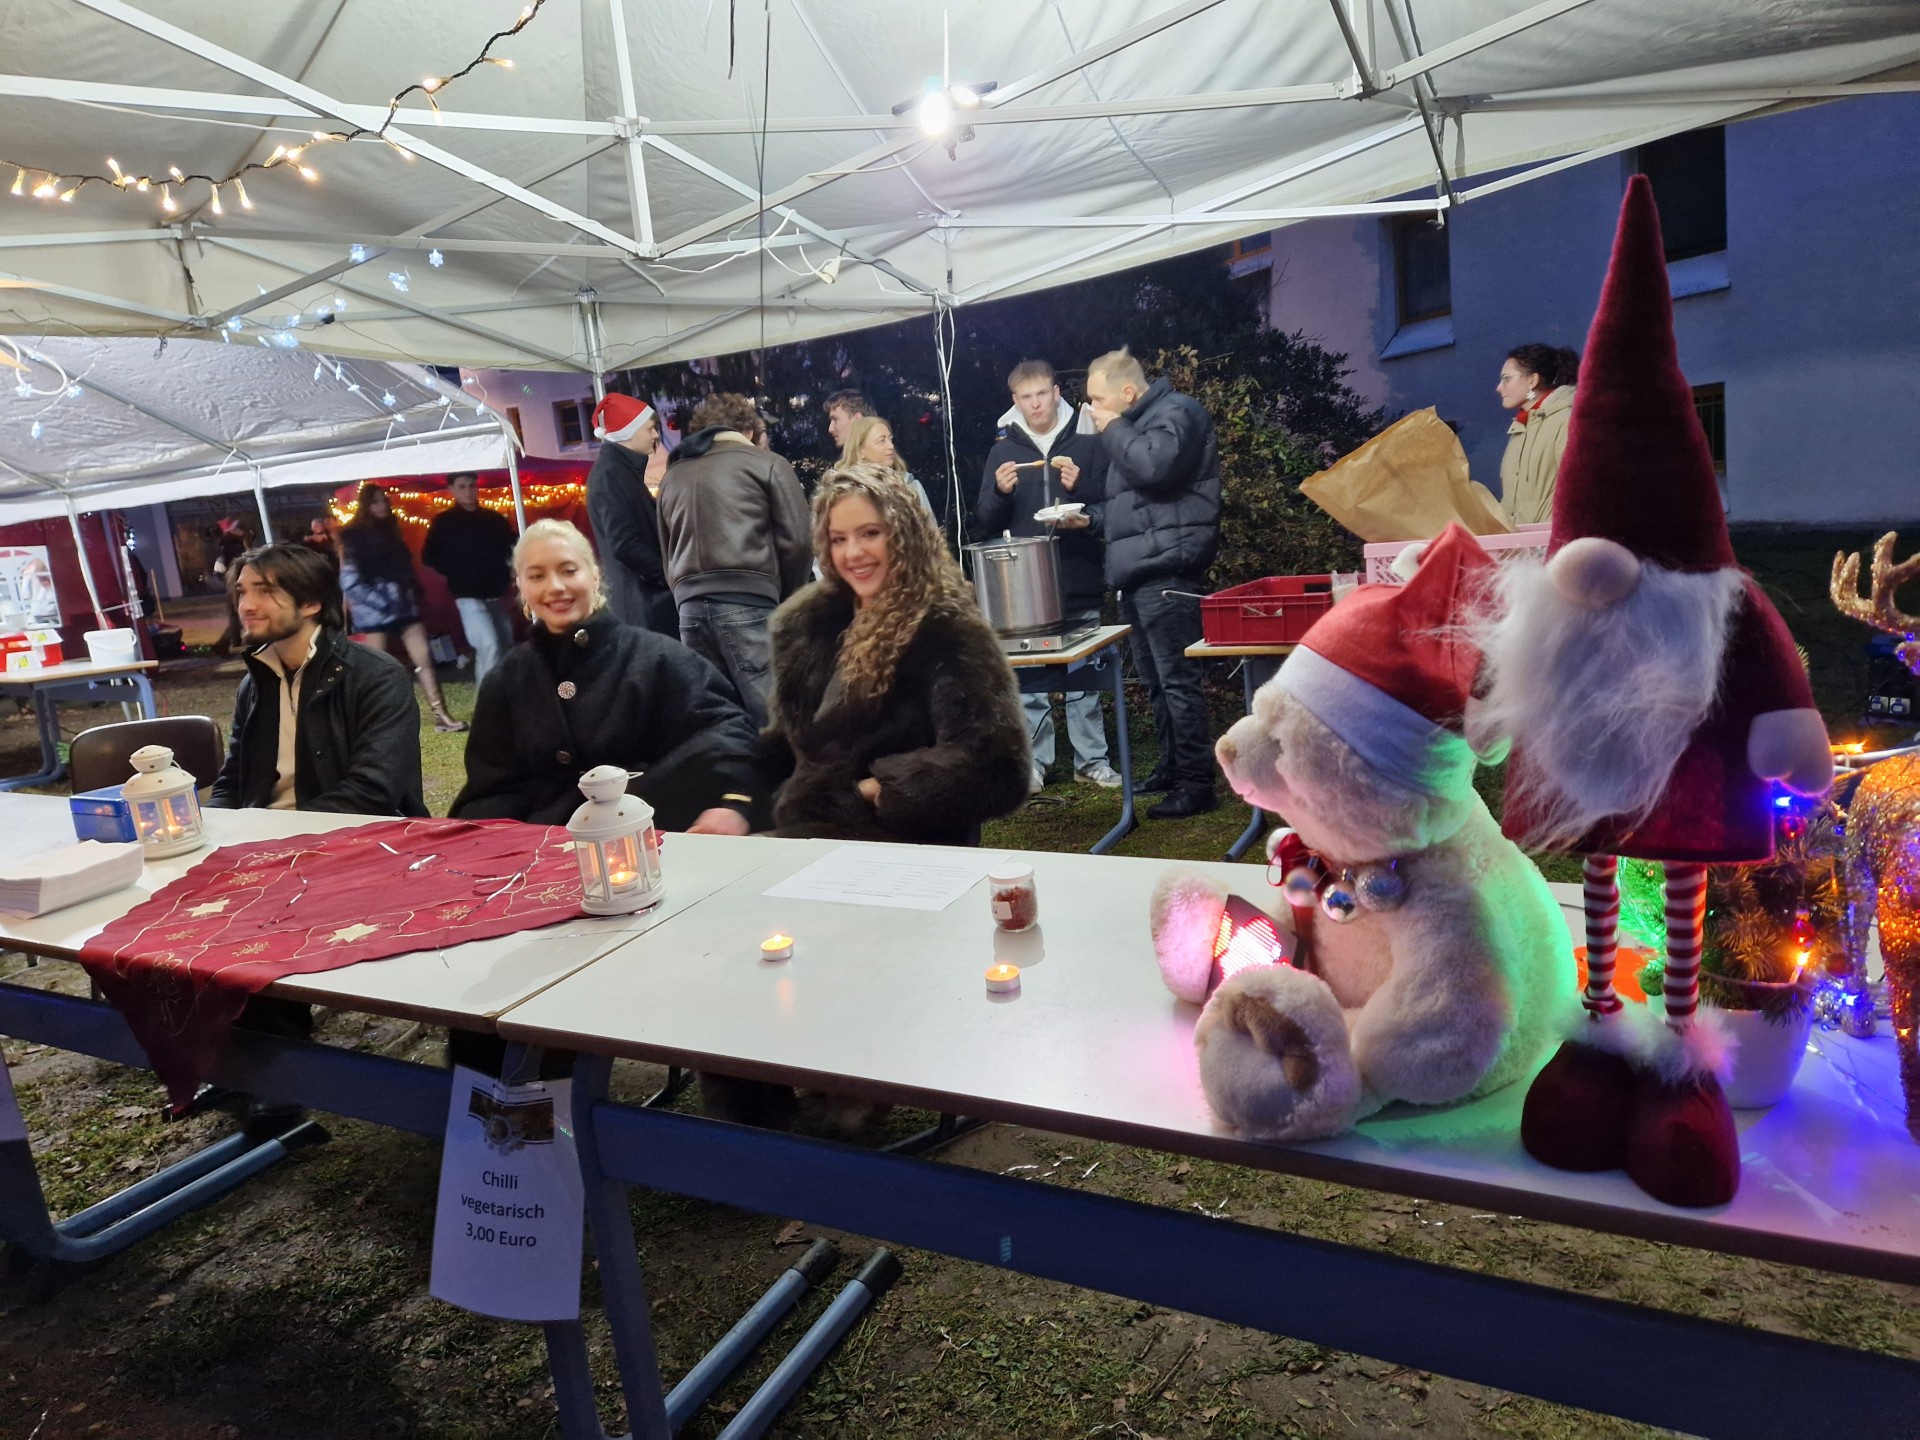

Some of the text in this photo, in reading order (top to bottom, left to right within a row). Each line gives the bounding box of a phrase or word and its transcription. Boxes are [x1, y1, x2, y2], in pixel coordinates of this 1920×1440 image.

[482, 1170, 518, 1189] Chilli
[461, 1194, 544, 1219] vegetarisch
[465, 1222, 537, 1247] 3,00 Euro
